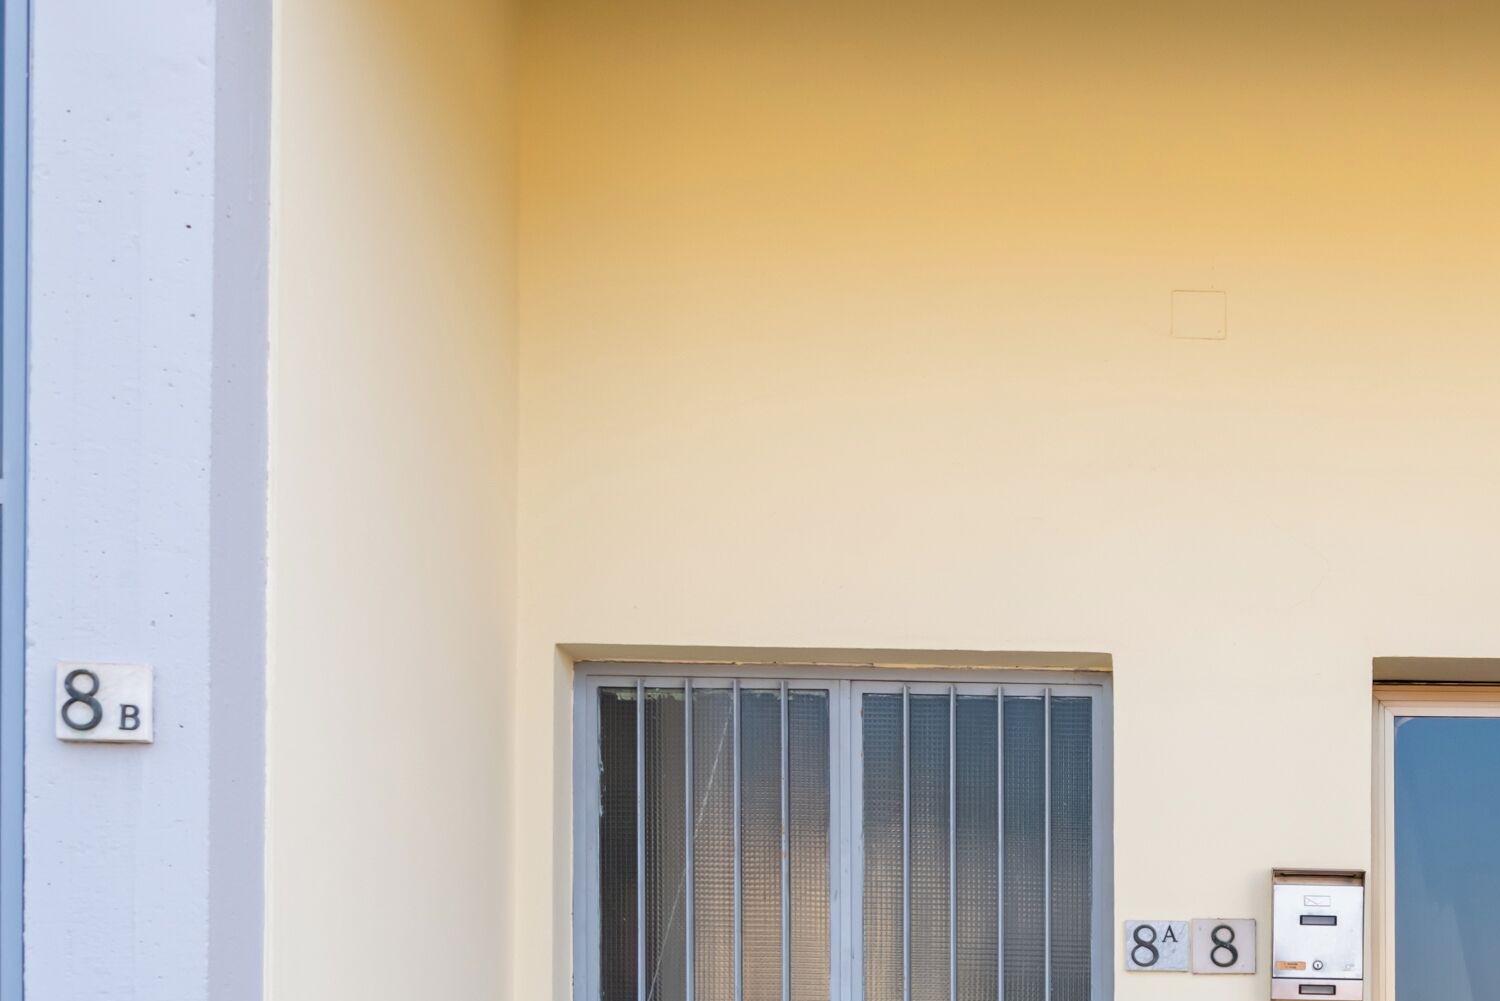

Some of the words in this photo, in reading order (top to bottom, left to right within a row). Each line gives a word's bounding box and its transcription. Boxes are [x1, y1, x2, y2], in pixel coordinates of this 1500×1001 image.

[61, 668, 103, 731] 8
[118, 703, 141, 731] B
[1210, 924, 1238, 968] 8
